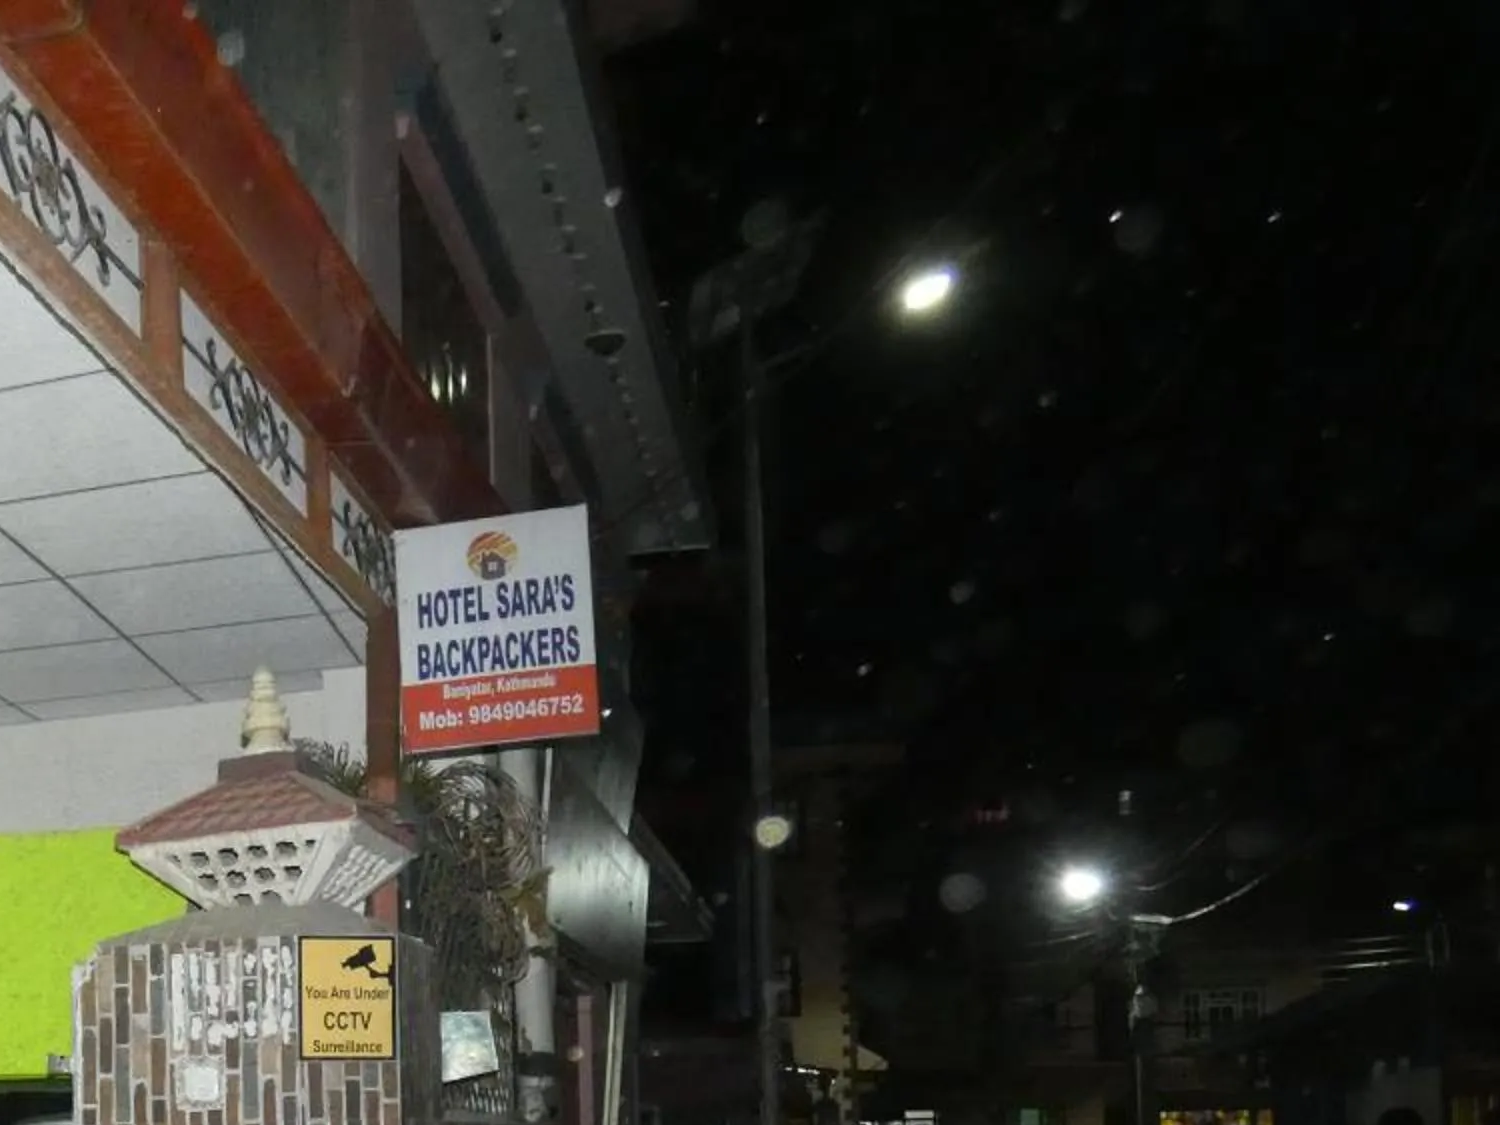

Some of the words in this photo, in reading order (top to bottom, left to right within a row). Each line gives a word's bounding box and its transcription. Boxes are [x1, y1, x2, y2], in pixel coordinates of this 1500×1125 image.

[418, 586, 490, 628] HOTEL
[496, 574, 576, 619] SARA'S
[418, 625, 582, 680] BACKPACKERS
[419, 710, 463, 731] Mob:
[468, 694, 584, 725] 9849046752
[305, 986, 329, 1000] You
[331, 985, 350, 999] Are
[354, 984, 389, 1000] Under
[323, 1011, 372, 1030] CCTV
